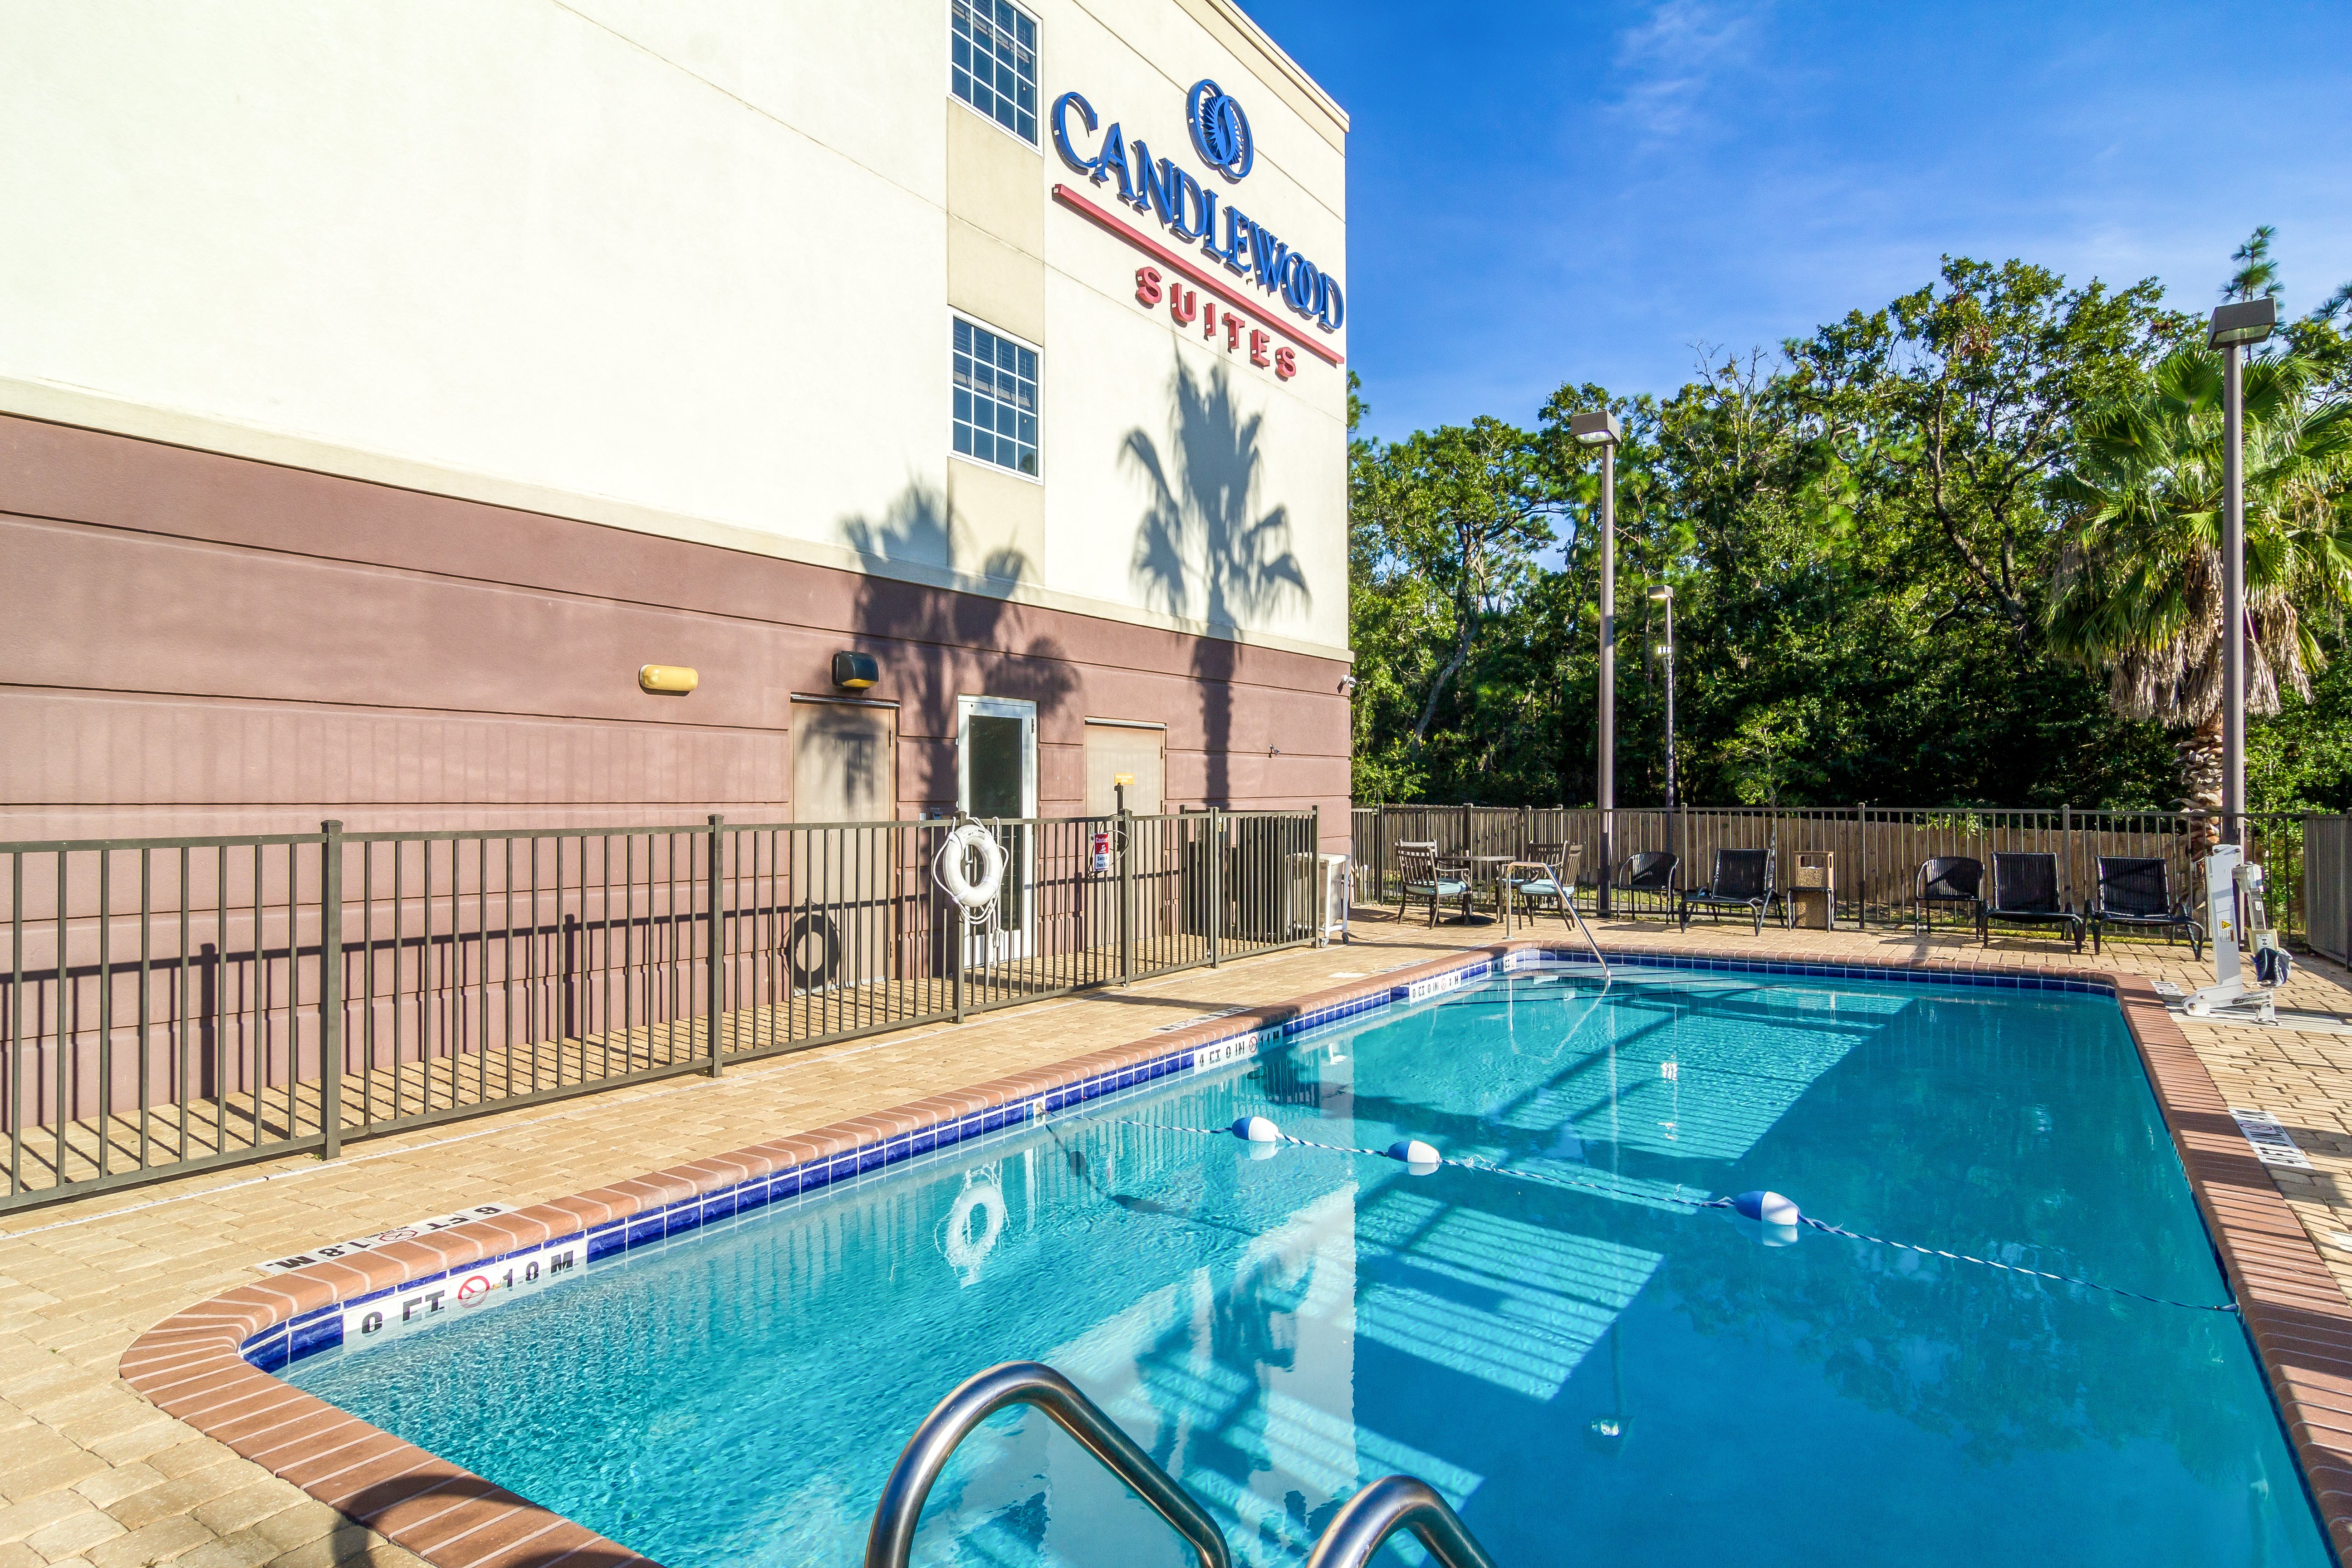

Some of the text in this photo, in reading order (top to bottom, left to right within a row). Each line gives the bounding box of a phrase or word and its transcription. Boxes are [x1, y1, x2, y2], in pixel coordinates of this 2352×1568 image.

[1051, 92, 1344, 330] CANDLEWOOD
[1137, 266, 1296, 377] SUITES
[318, 1242, 371, 1257] 1.8
[426, 1217, 470, 1230] FT
